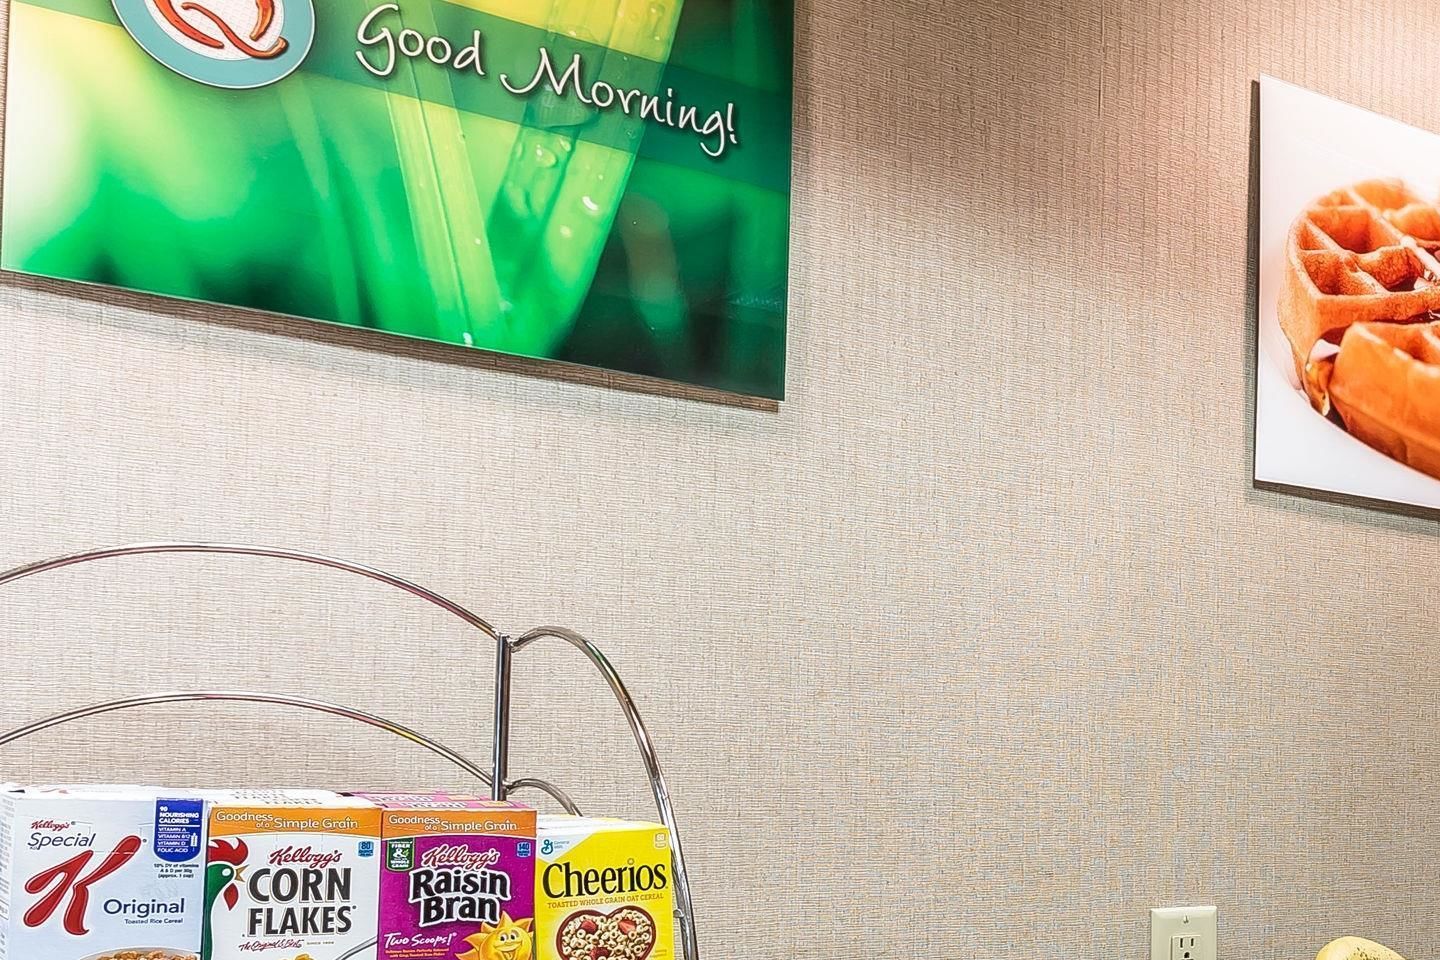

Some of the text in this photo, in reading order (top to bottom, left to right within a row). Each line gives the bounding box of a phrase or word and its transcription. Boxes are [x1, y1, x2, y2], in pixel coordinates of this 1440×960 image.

[356, 4, 740, 156] Good Morning!
[31, 819, 70, 832] Kellogg's
[216, 811, 273, 822] Goodness
[274, 817, 319, 830] Simple
[322, 817, 358, 829] Grain
[388, 814, 441, 824] Goodness
[440, 820, 482, 832] Simple
[484, 820, 517, 831] Grain
[27, 832, 97, 850] Special
[270, 846, 343, 868] Kellogg's
[422, 845, 499, 869] Kellogg's
[24, 834, 142, 936] K
[247, 867, 352, 902] CORN
[410, 868, 509, 901] Raisin
[543, 858, 668, 899] Cheerios
[103, 897, 185, 918] Original
[420, 896, 499, 925] Bran
[547, 892, 664, 909] TOASTED WHOLE GRAIN OAT CEREAL
[248, 905, 352, 936] FLAKES
[384, 932, 453, 949] Two Scoops!
